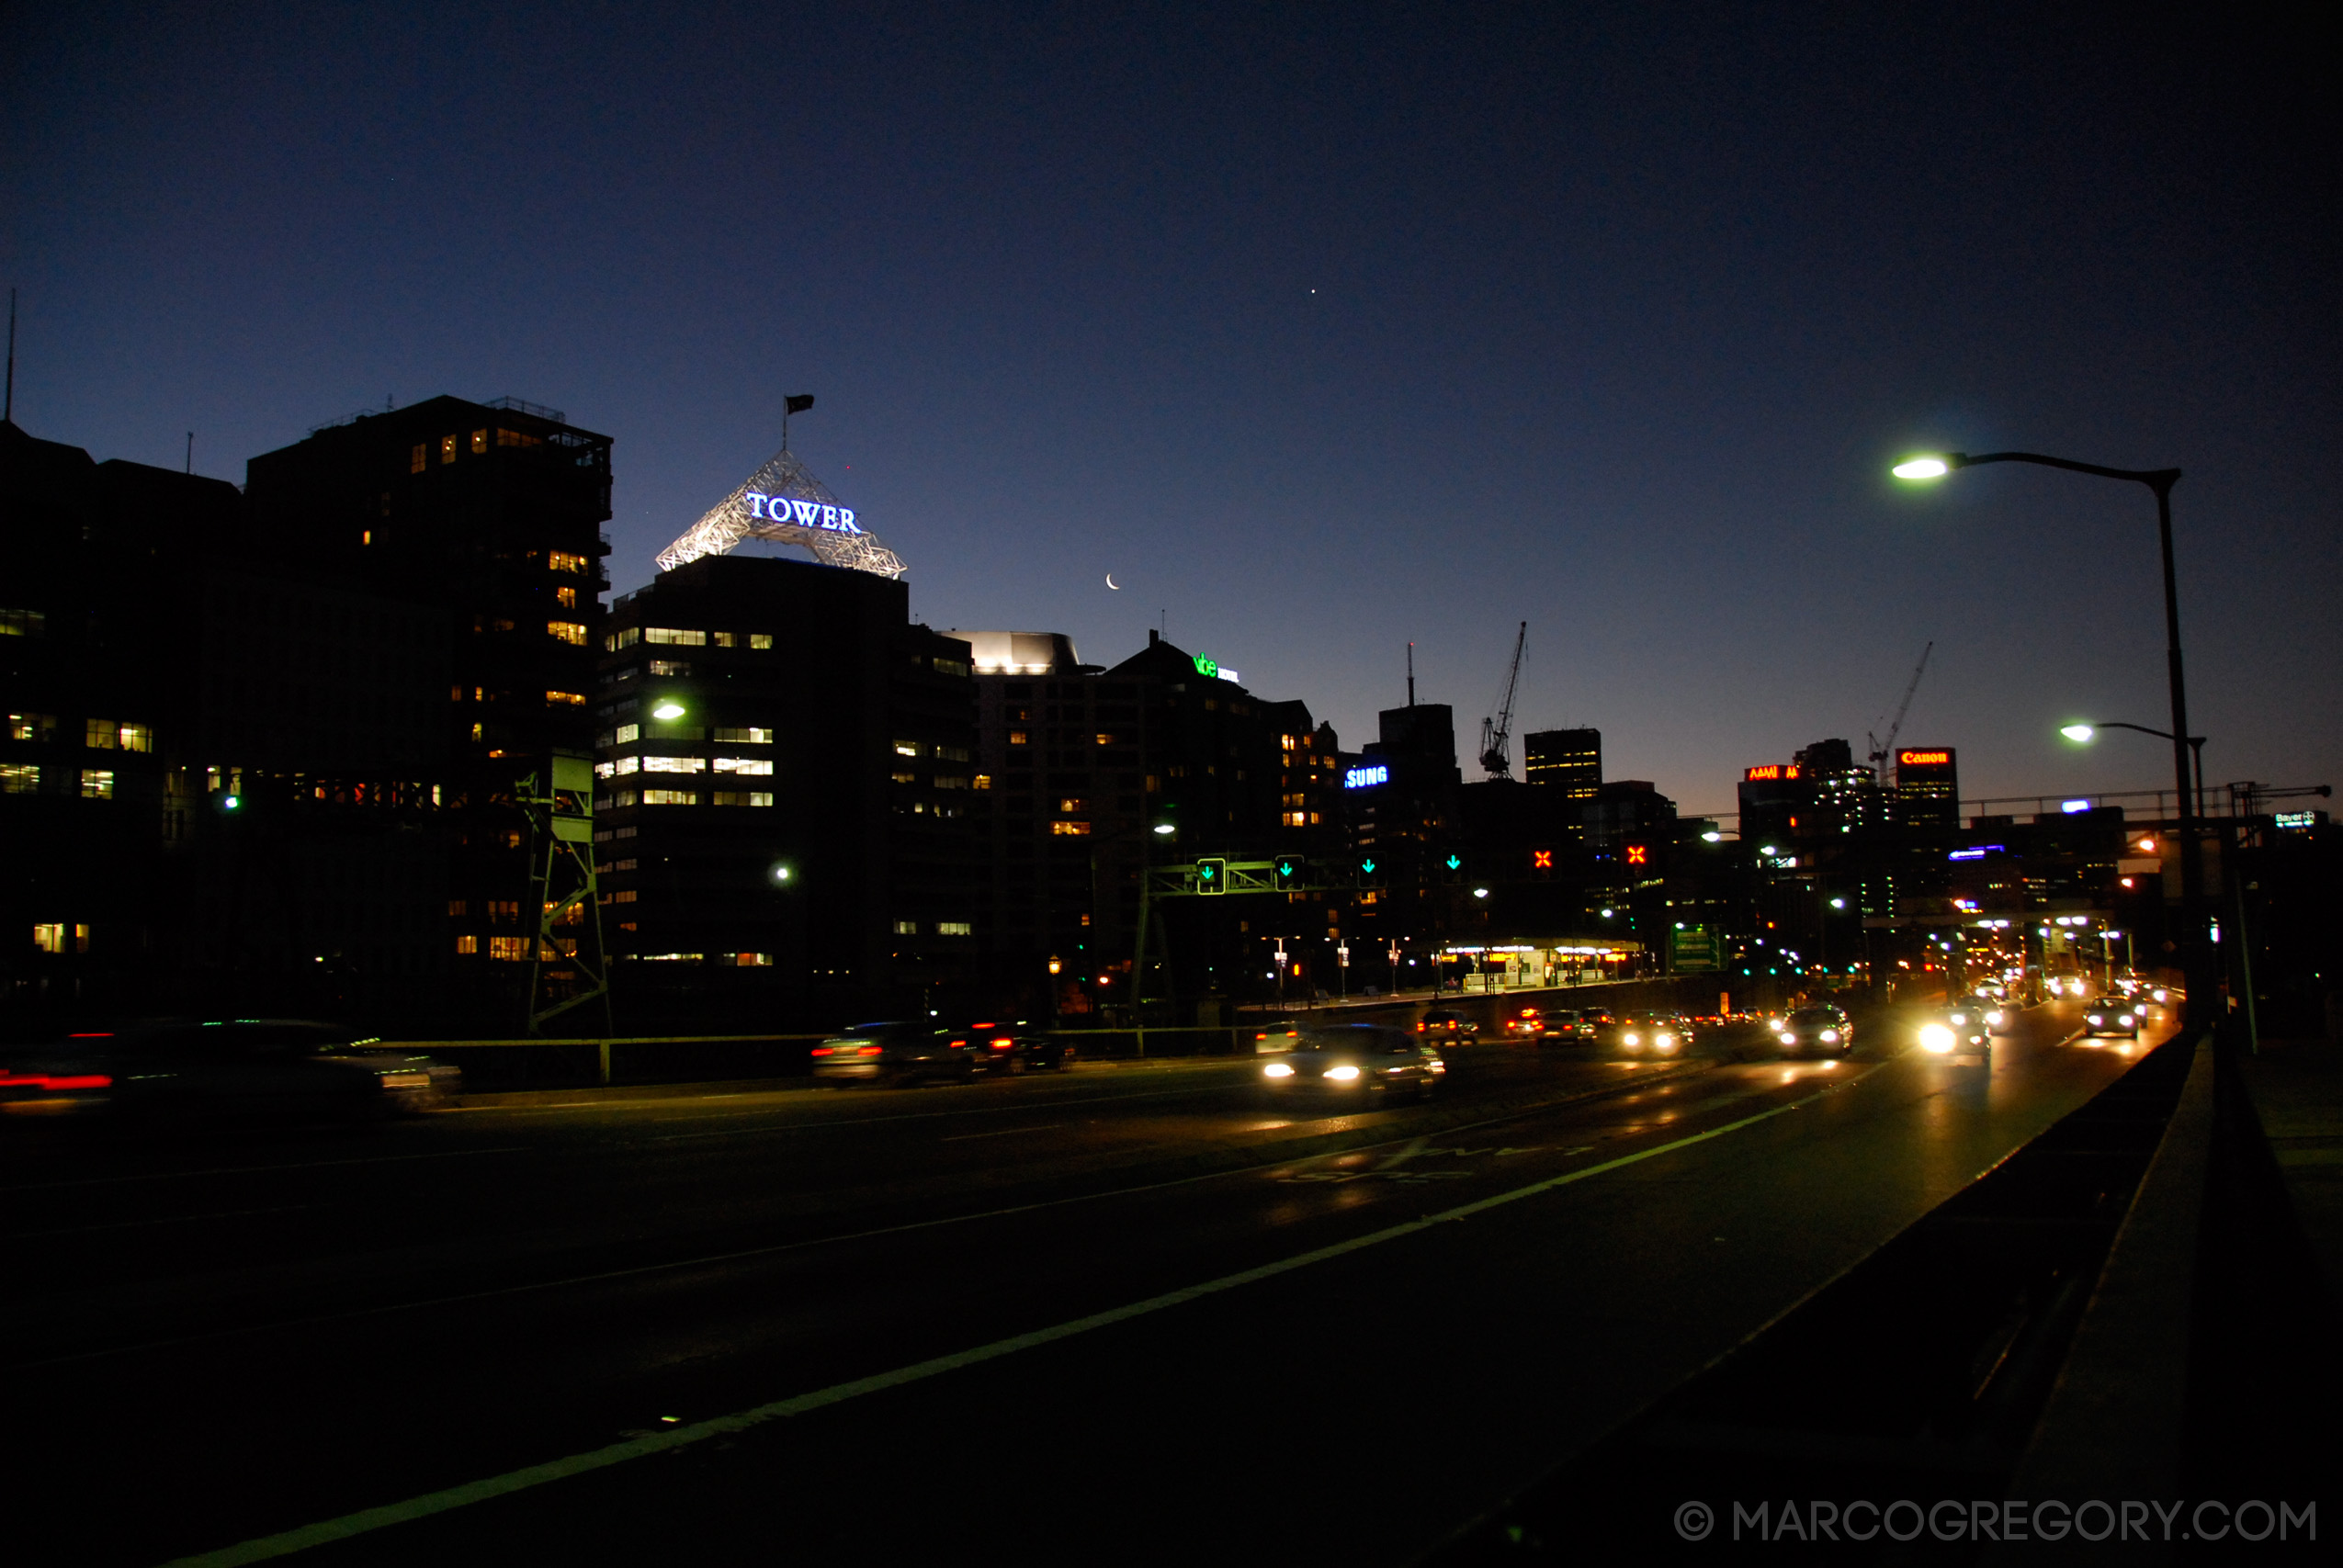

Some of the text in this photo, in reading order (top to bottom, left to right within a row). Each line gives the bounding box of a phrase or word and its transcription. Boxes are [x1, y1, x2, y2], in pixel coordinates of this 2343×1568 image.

[746, 492, 861, 534] TOWER
[1901, 751, 1948, 764] Canon
[1344, 765, 1388, 788] SUNG
[1749, 765, 1778, 780] AAMI
[2275, 814, 2302, 822] Bayer
